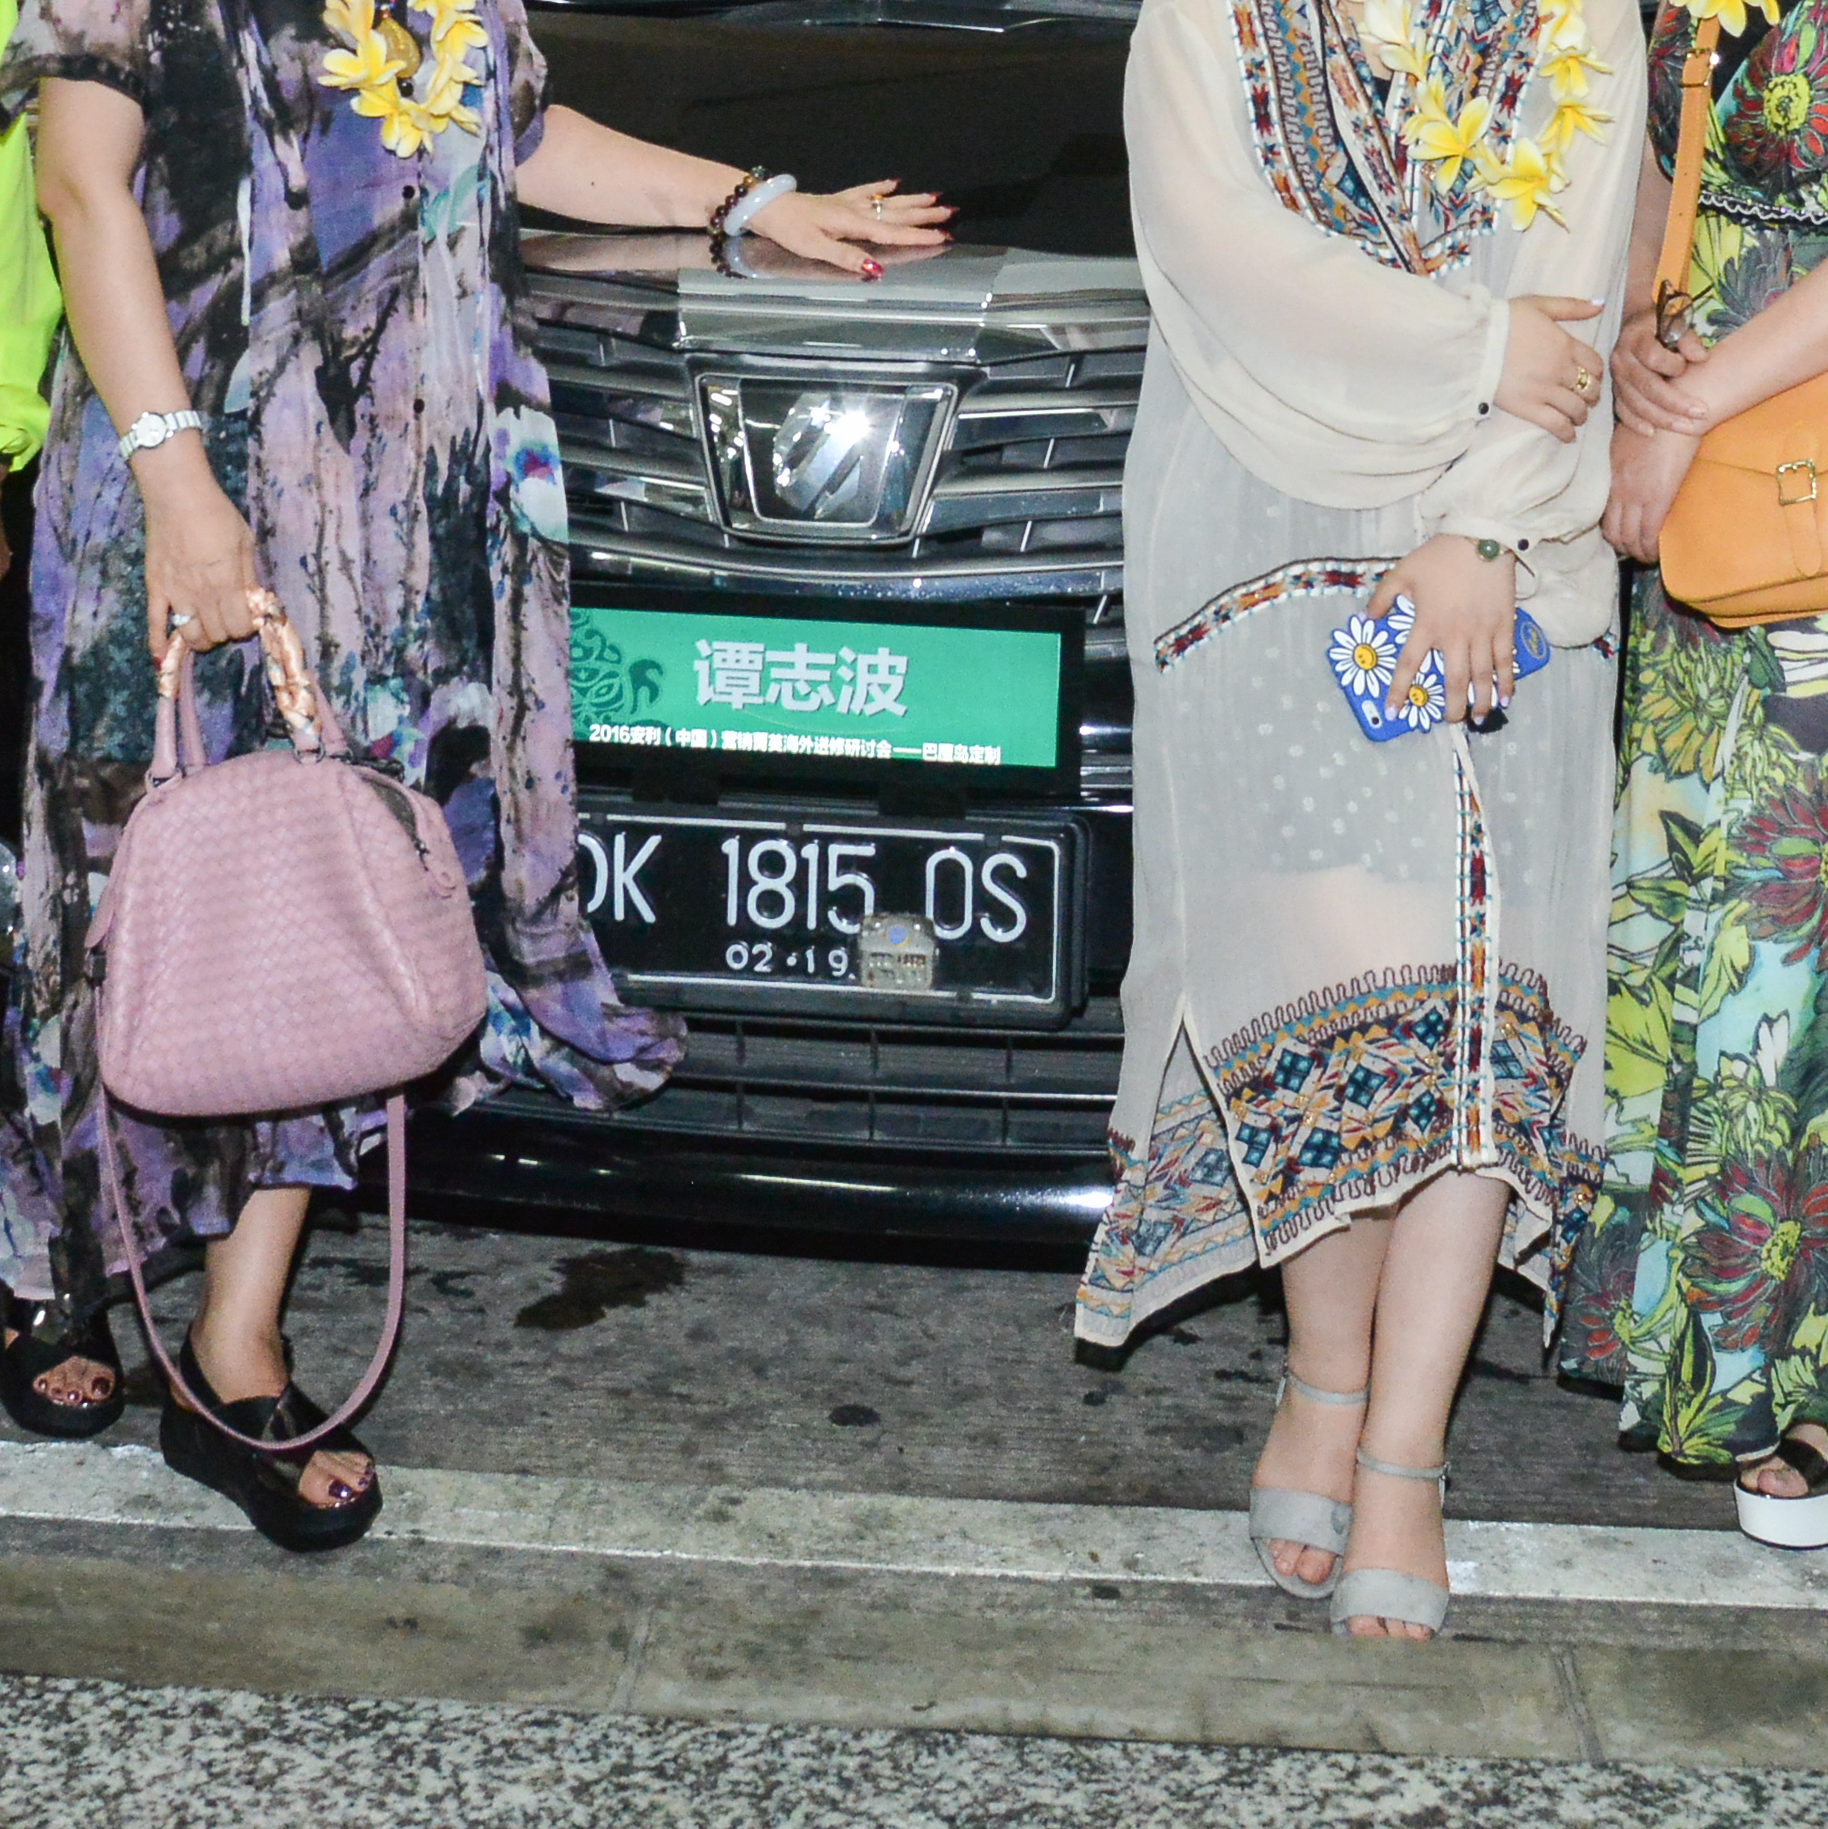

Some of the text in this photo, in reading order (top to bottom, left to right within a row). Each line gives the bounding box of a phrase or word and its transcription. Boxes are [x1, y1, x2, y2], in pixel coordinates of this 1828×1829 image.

[693, 639, 909, 718] 谭志波
[721, 832, 876, 935] 1815
